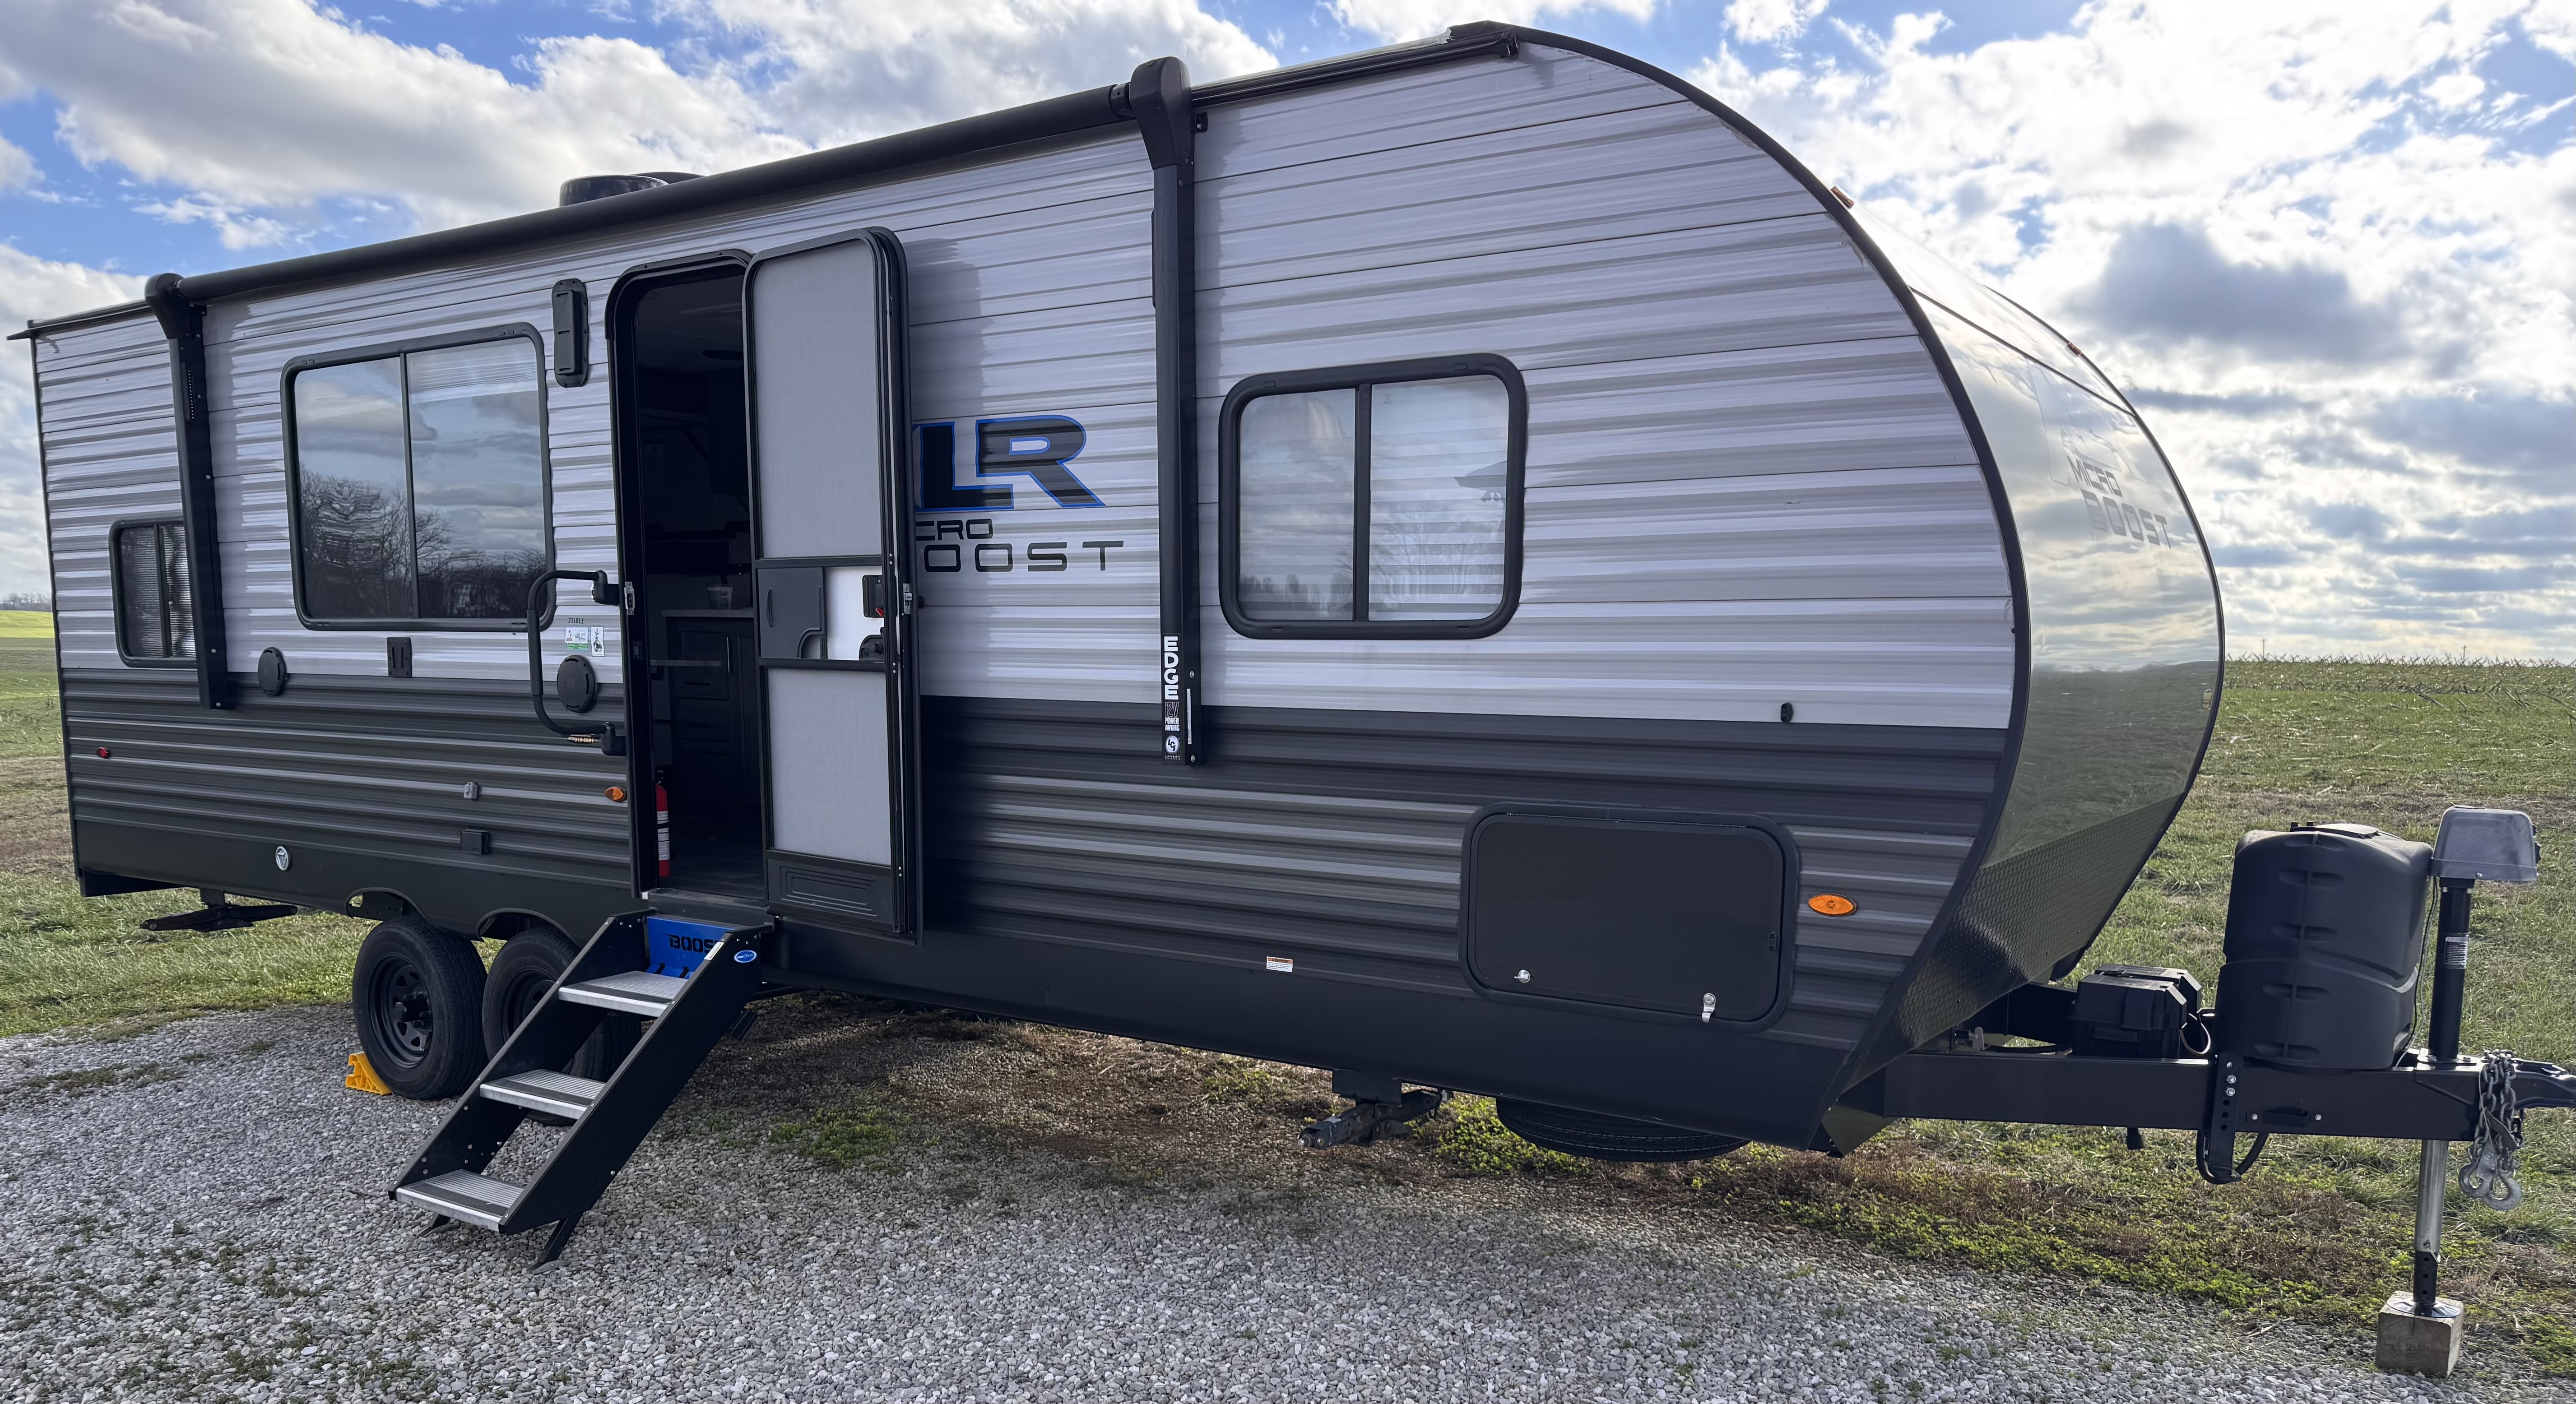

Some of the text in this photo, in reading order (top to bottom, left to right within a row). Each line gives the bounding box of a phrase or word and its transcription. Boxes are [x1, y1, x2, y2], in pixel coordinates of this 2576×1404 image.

[913, 414, 1106, 511] LR
[2066, 455, 2122, 497] MICRO
[2081, 489, 2171, 549] BOOST
[1164, 636, 1179, 700] EDGE
[1165, 701, 1179, 717] 12V
[1165, 717, 1179, 725] POWER
[664, 933, 719, 954] BOOS
